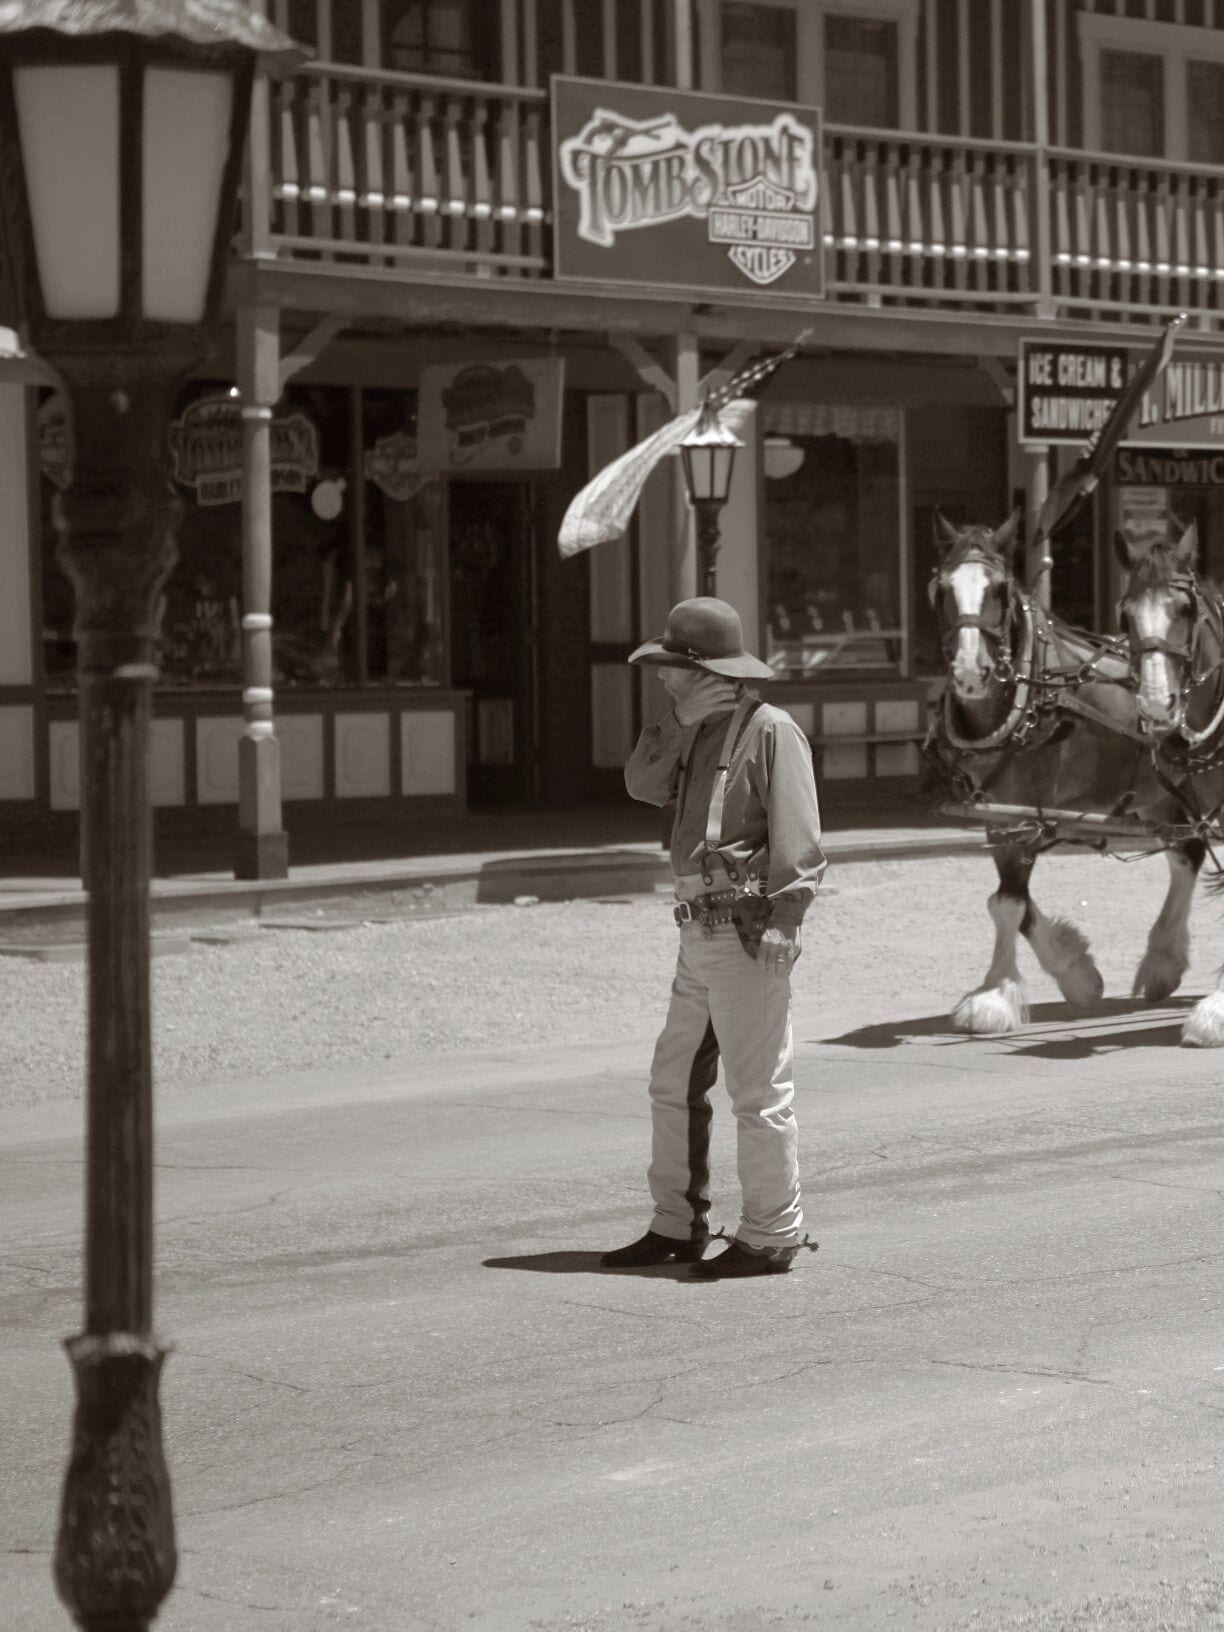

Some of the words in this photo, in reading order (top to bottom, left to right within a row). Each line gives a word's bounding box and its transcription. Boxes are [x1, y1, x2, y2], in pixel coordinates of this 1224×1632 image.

[569, 124, 813, 240] TOMBSTONE
[736, 246, 789, 277] CYCLES
[1029, 353, 1053, 386] ICE
[1058, 354, 1106, 388] CREAM
[1110, 356, 1122, 389] &
